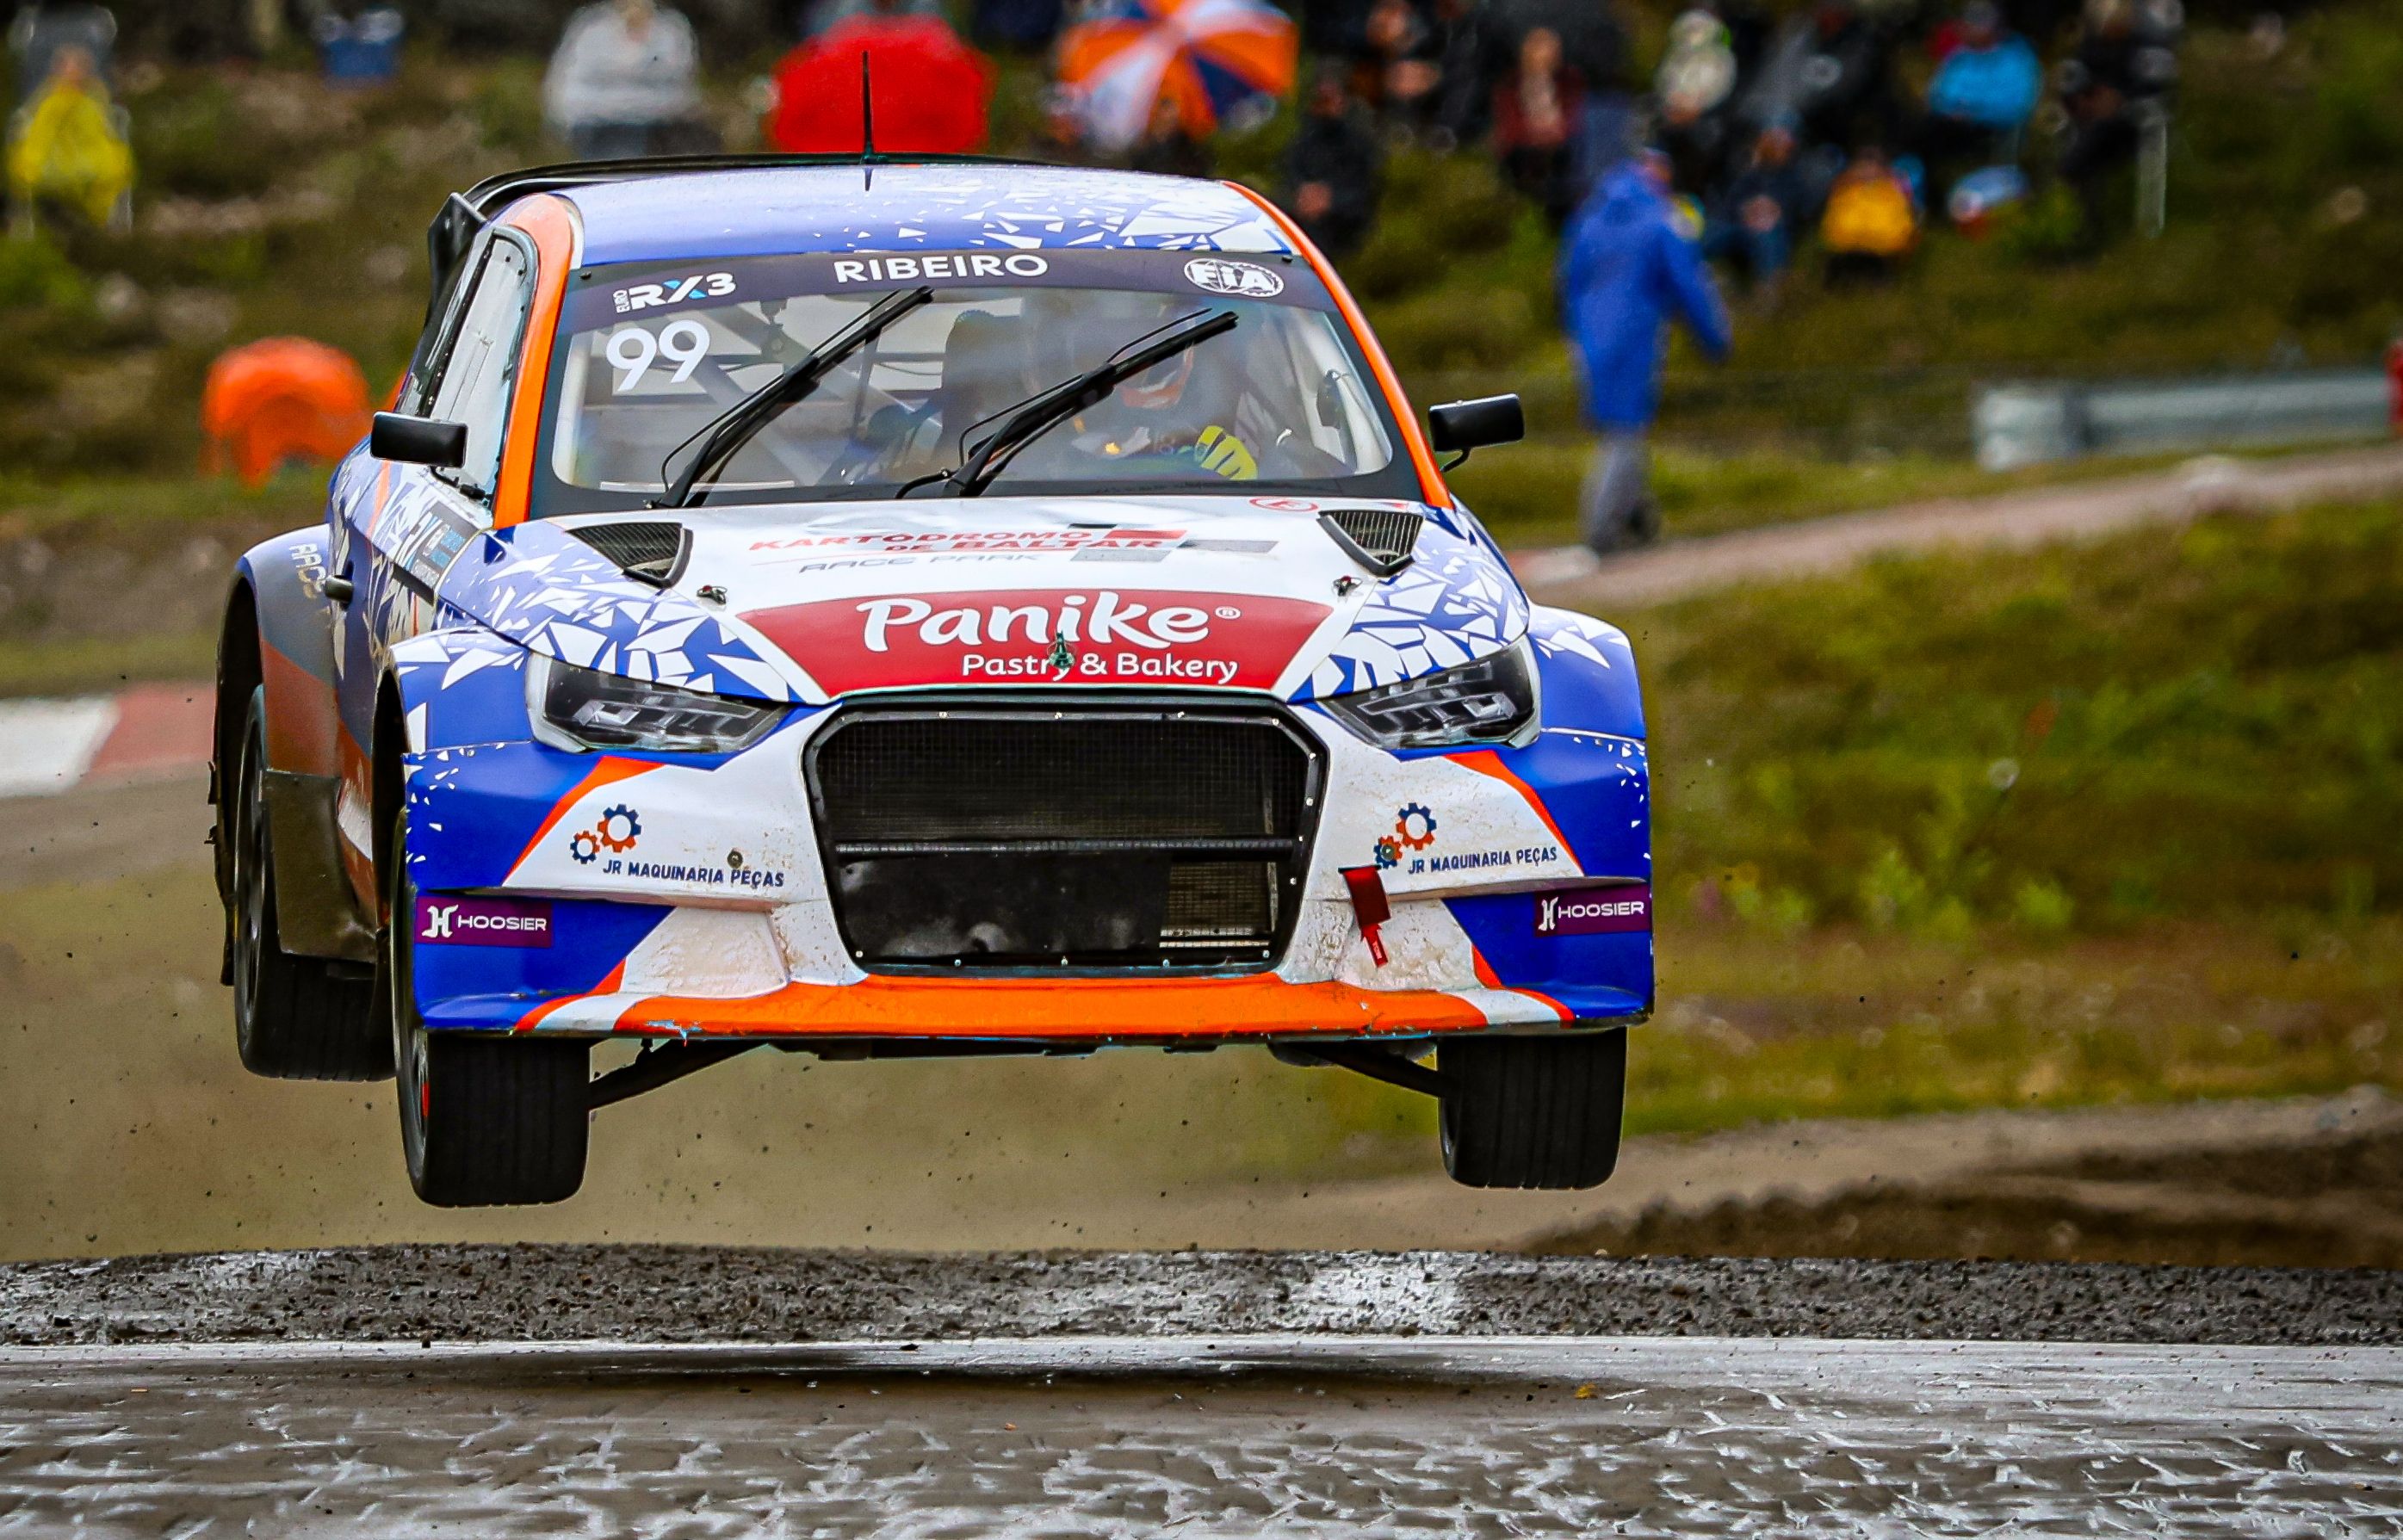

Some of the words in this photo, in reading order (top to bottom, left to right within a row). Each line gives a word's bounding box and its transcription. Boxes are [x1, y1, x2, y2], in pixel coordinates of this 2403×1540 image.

[833, 255, 1049, 283] RIBEIRO
[1187, 261, 1279, 294] FIA
[628, 272, 736, 310] RX3
[606, 319, 710, 392] 99
[748, 531, 1093, 551] KARTODROMO
[949, 540, 1164, 550] BALTAR
[1080, 652, 1108, 676] &
[1117, 652, 1238, 684] Bakery
[603, 859, 622, 875] JR
[628, 863, 723, 884] MAQUINARIA
[731, 869, 785, 889] PEÇAS
[1408, 858, 1425, 875] JR
[1430, 851, 1513, 873] MAQUINARIA
[1516, 845, 1558, 868] PEÇAS
[457, 913, 548, 931] HOOSIER
[1558, 900, 1645, 918] HOOSIER
